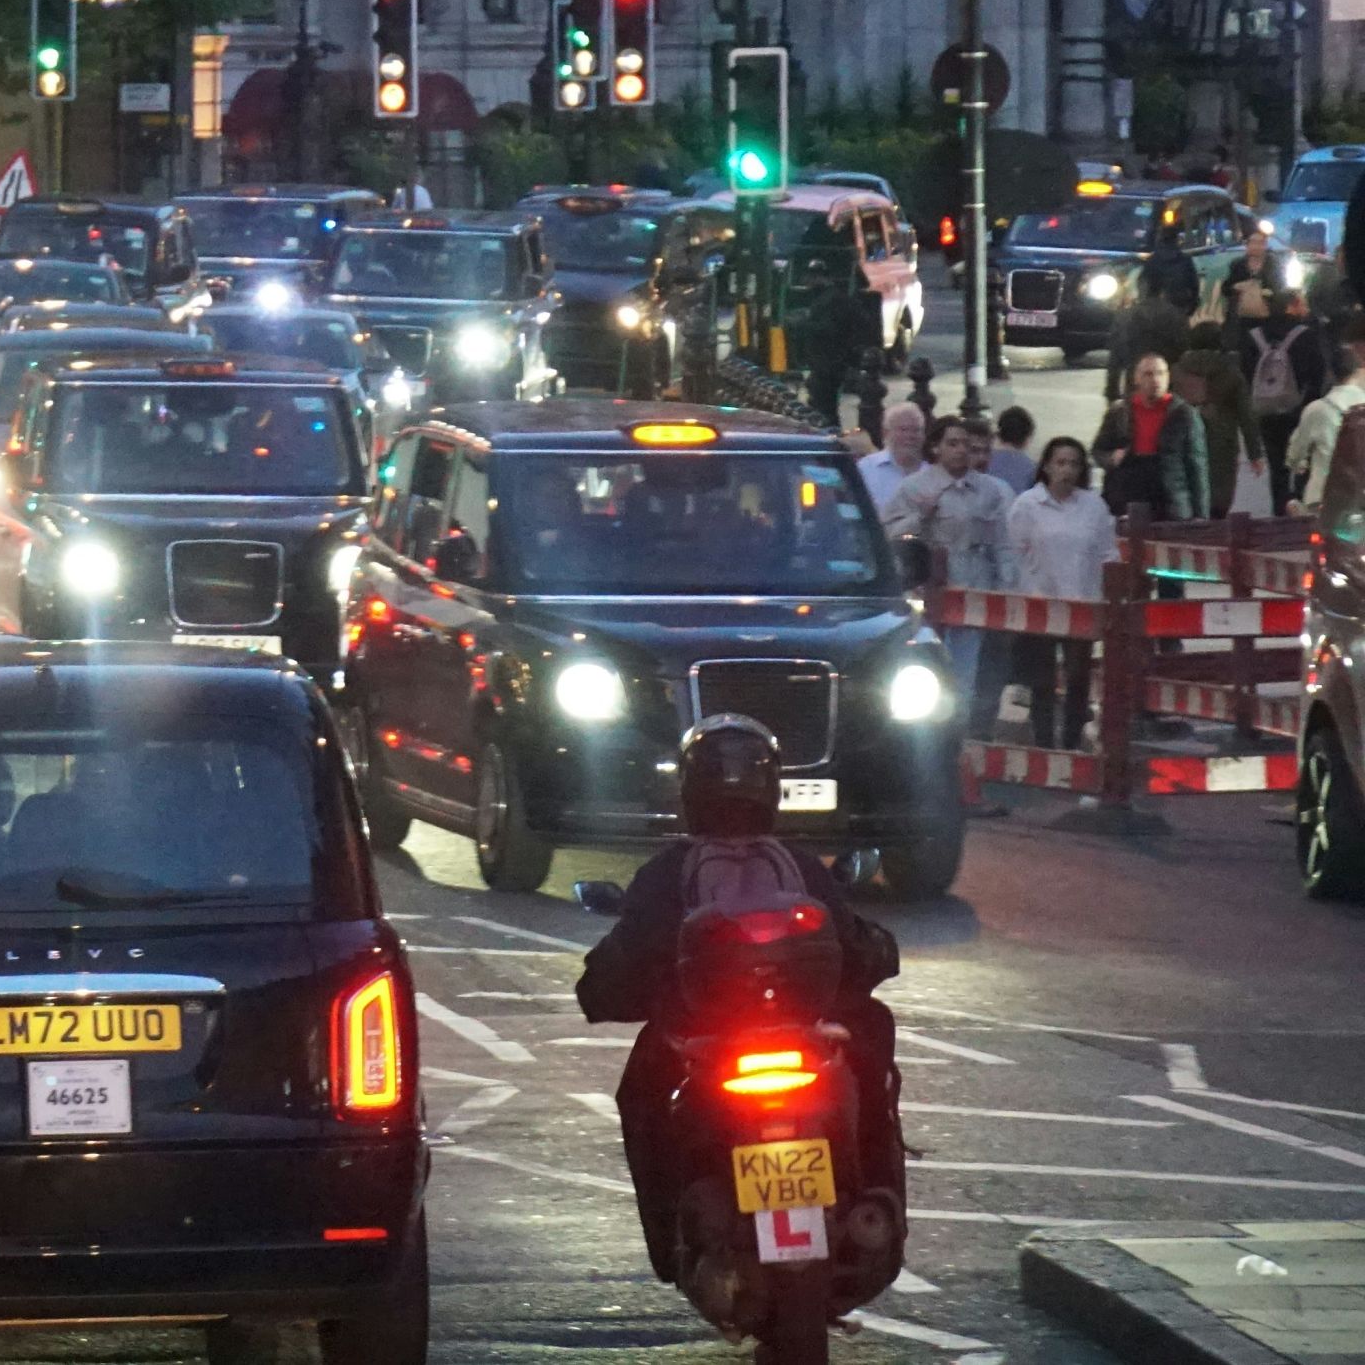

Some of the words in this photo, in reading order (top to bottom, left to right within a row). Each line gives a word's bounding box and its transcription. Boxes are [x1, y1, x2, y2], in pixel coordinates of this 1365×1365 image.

[5, 948, 145, 960] LEVC
[93, 1009, 164, 1042] UUO
[46, 1087, 109, 1105] 46625
[739, 1147, 826, 1178] KN22
[772, 1210, 812, 1247] L
